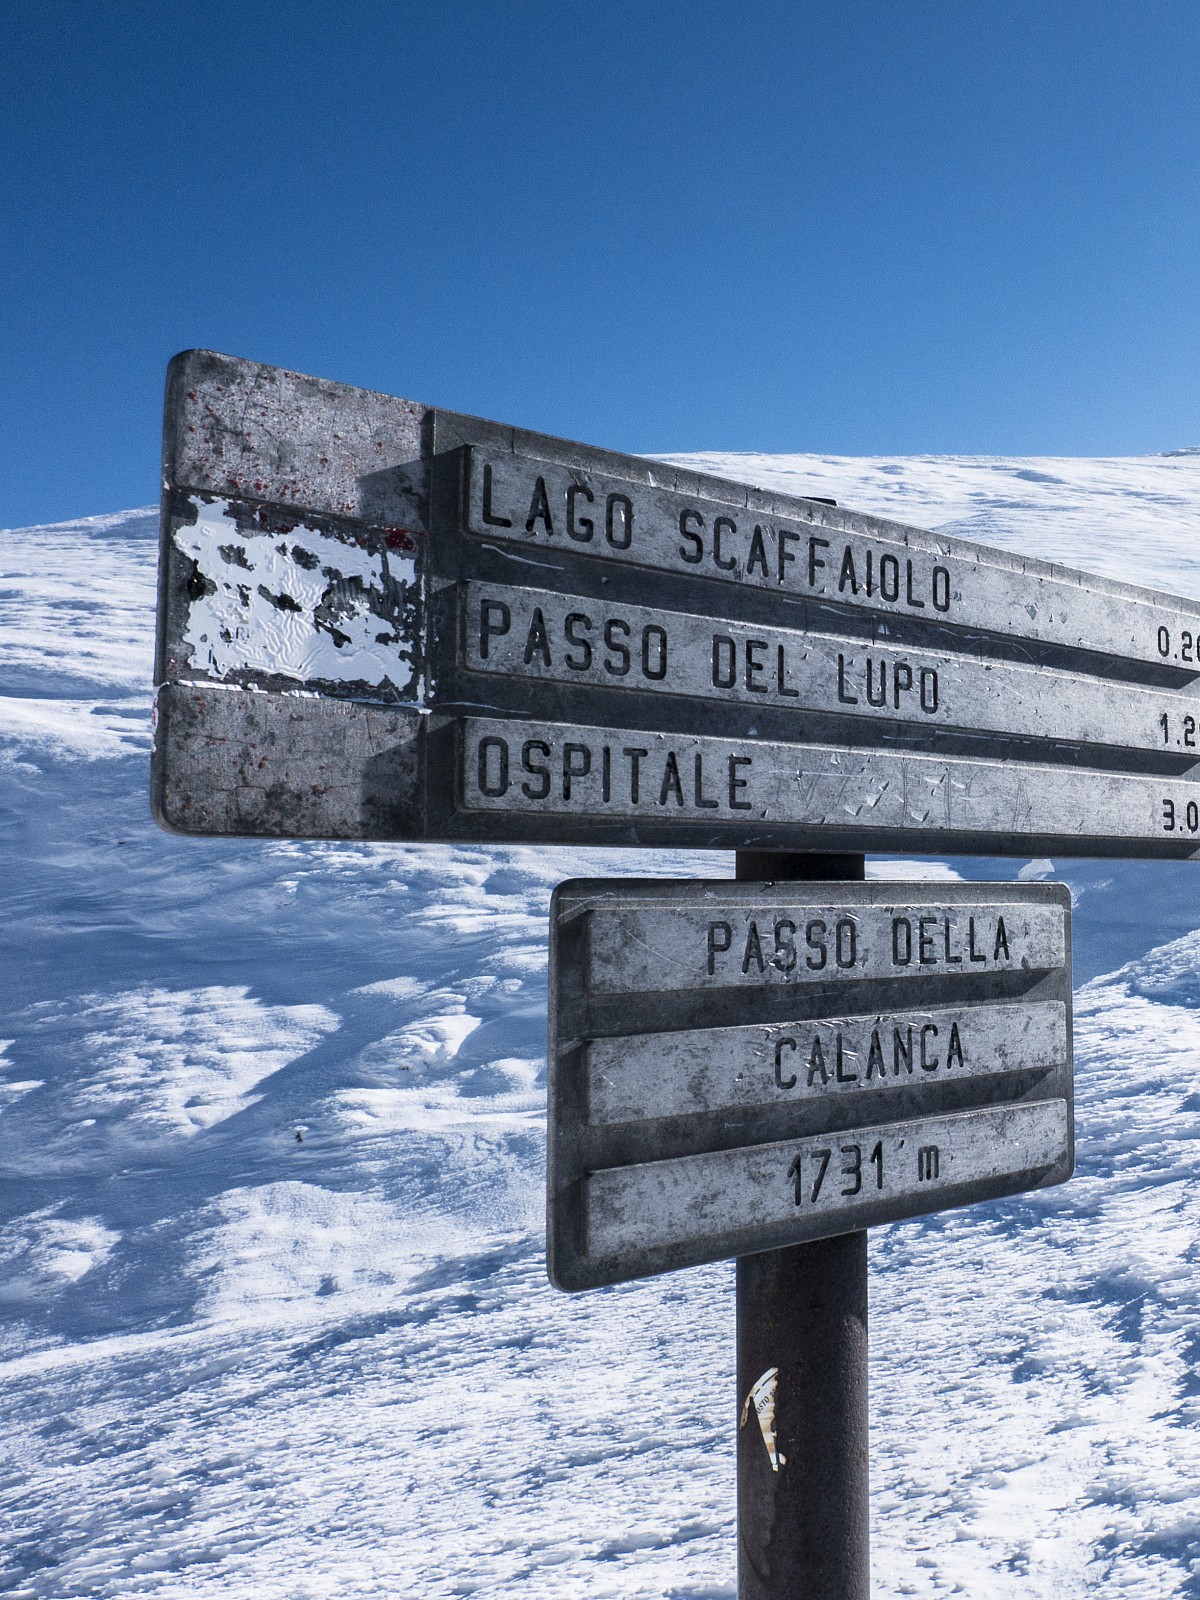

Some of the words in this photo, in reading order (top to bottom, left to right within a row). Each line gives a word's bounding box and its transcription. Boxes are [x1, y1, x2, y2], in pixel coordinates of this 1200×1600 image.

[482, 464, 632, 550] LAGO
[679, 509, 951, 612] SCAFFAIOLO
[479, 598, 668, 681] PASSO
[711, 634, 799, 697] DEL
[837, 653, 939, 714] LUPO
[478, 735, 752, 810] OSPITALE
[707, 918, 856, 976] PASSO
[892, 915, 1010, 967] DELLA
[774, 1021, 965, 1090] CALANCA
[787, 1140, 884, 1206] 1731
[918, 1144, 940, 1182] m
